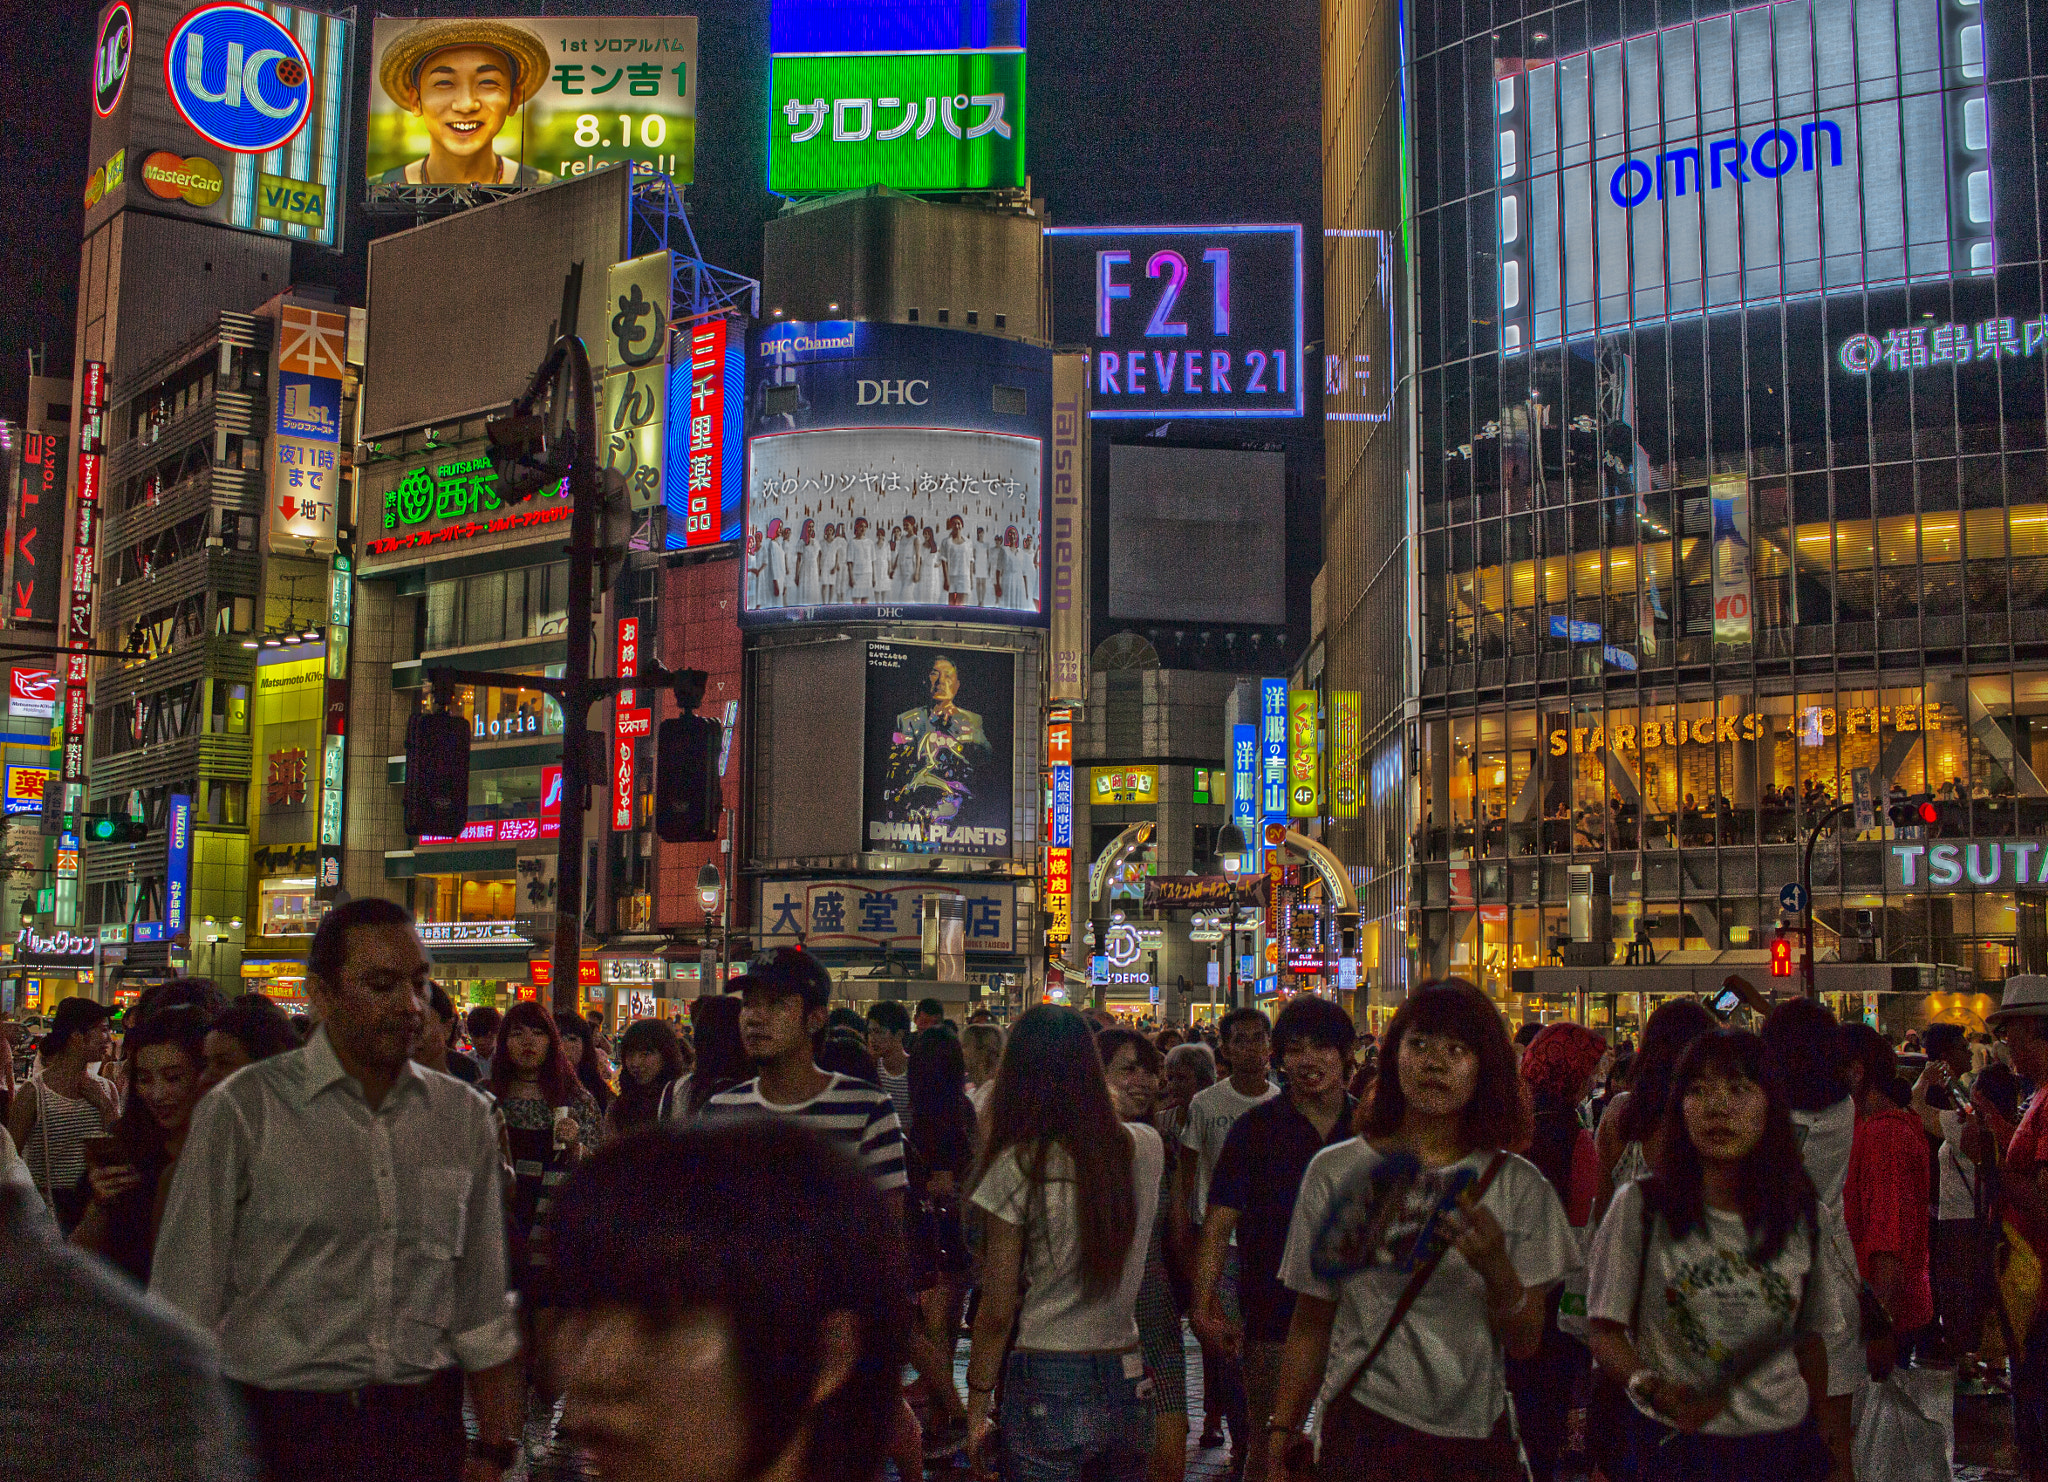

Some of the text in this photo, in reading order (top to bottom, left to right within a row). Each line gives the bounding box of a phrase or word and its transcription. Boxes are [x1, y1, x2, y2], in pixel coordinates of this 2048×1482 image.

[561, 38, 684, 53] 1st ソロアルバム
[186, 33, 299, 118] UC
[574, 114, 666, 148] 8.10
[783, 93, 1011, 142] サロンパス
[145, 165, 223, 193] MasterCard
[560, 154, 676, 176] relese!!
[266, 187, 323, 216] VISA
[760, 334, 855, 356] DHC Channel
[1100, 350, 1287, 394] REVER 21
[606, 284, 665, 500] もんじゃ
[856, 380, 929, 406] DHC
[283, 420, 334, 434] ブックファースト
[687, 332, 716, 532] 三千里薬品
[42, 435, 56, 491] TOKYO
[278, 444, 335, 471] 夜11時
[289, 469, 323, 491] まで
[762, 472, 1027, 500] 次のハリツヤは、あなたです。
[300, 499, 333, 522] 地下
[384, 490, 398, 529] 渋谷
[1055, 393, 1078, 611] Taisei neon
[877, 607, 904, 619] DHC
[261, 675, 304, 689] Matsumoto
[1292, 702, 1314, 782] くいしんぼ
[1549, 702, 1942, 756] STARBUCKS COFFEE
[1264, 686, 1287, 812] 洋服の青山
[16, 769, 44, 798] 薬
[267, 747, 309, 806] 薬
[616, 742, 632, 826] もんじゃ焼
[1056, 769, 1070, 844] 大盛堂商事ビル
[1294, 789, 1312, 803] 4F
[176, 804, 188, 850] MIZUHO
[502, 820, 535, 830] ハネムーン
[869, 821, 1007, 847] DMM PLANETS
[1892, 842, 2048, 886] TSUT
[1159, 879, 1252, 899] バスケットボールストート
[771, 890, 1002, 938] 大盛堂店
[453, 925, 516, 938] フルーツパーラー
